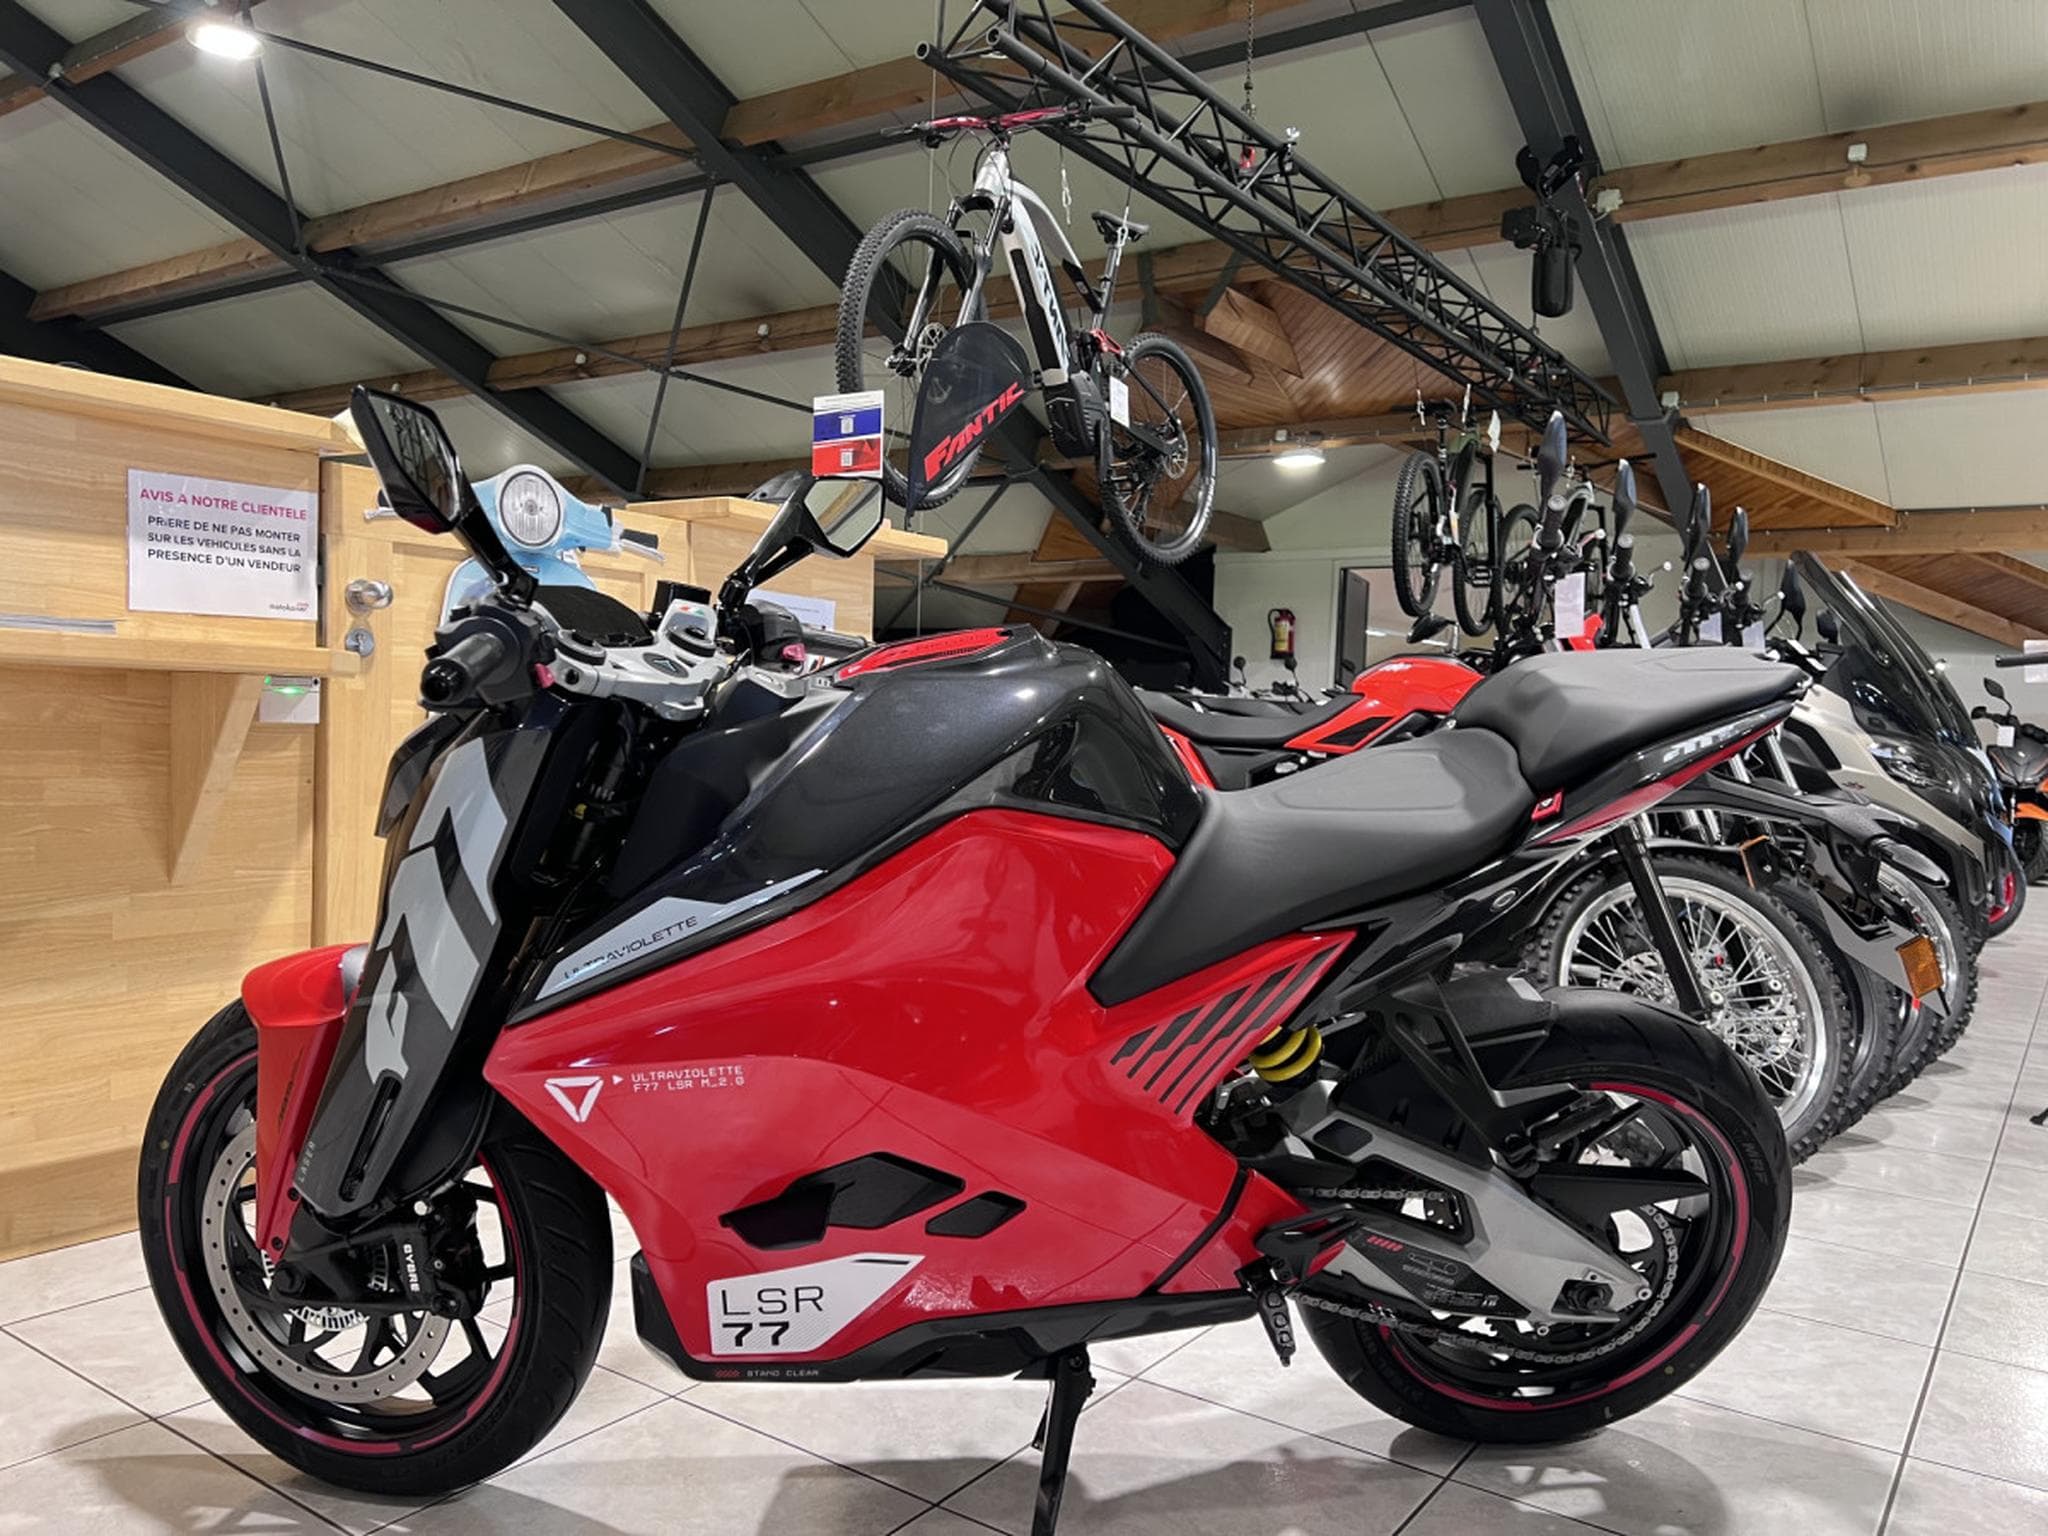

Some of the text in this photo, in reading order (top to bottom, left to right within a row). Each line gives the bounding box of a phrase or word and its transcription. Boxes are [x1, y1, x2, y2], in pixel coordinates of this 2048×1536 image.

[923, 381, 1025, 482] FANTIC
[140, 488, 307, 520] AVIS A NOTRE CLIENTELE
[194, 521, 209, 532] DE
[212, 523, 228, 534] NE
[230, 525, 252, 537] PAS
[255, 528, 301, 543] MONTER
[147, 532, 301, 558] SUR LES VEHICULES SANS LA
[147, 548, 301, 573] PRESENCE D'UN VENDEUR
[630, 1065, 745, 1083] ULTRAVIOLETTE
[632, 1081, 660, 1093] F77
[667, 1078, 694, 1091] LSR
[721, 1286, 826, 1316] LSR
[721, 1321, 791, 1348] 77
[746, 1368, 820, 1378] STAND CLEAR
